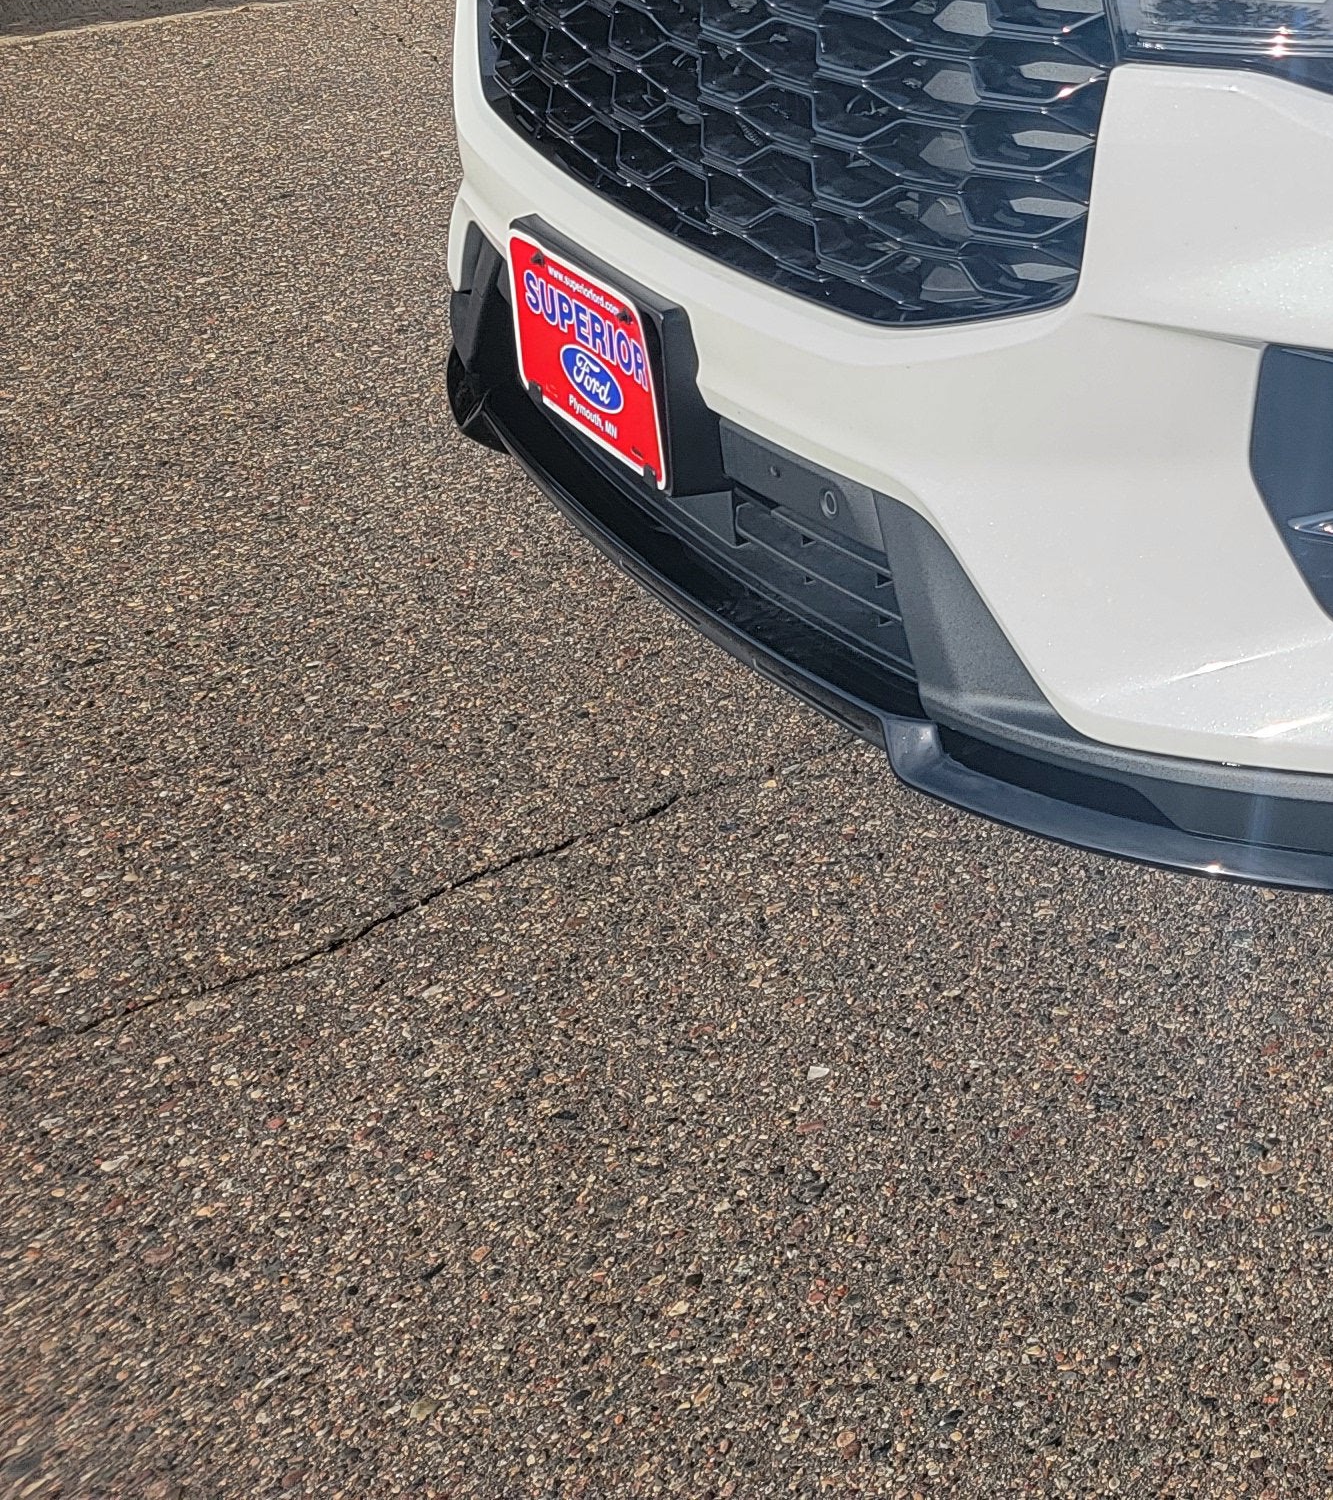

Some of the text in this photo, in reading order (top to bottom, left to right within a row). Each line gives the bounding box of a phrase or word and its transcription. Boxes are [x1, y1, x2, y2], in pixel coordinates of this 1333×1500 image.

[523, 269, 650, 393] SUPERIOR
[573, 352, 611, 405] Ford
[568, 393, 618, 440] Plymouth, MN
